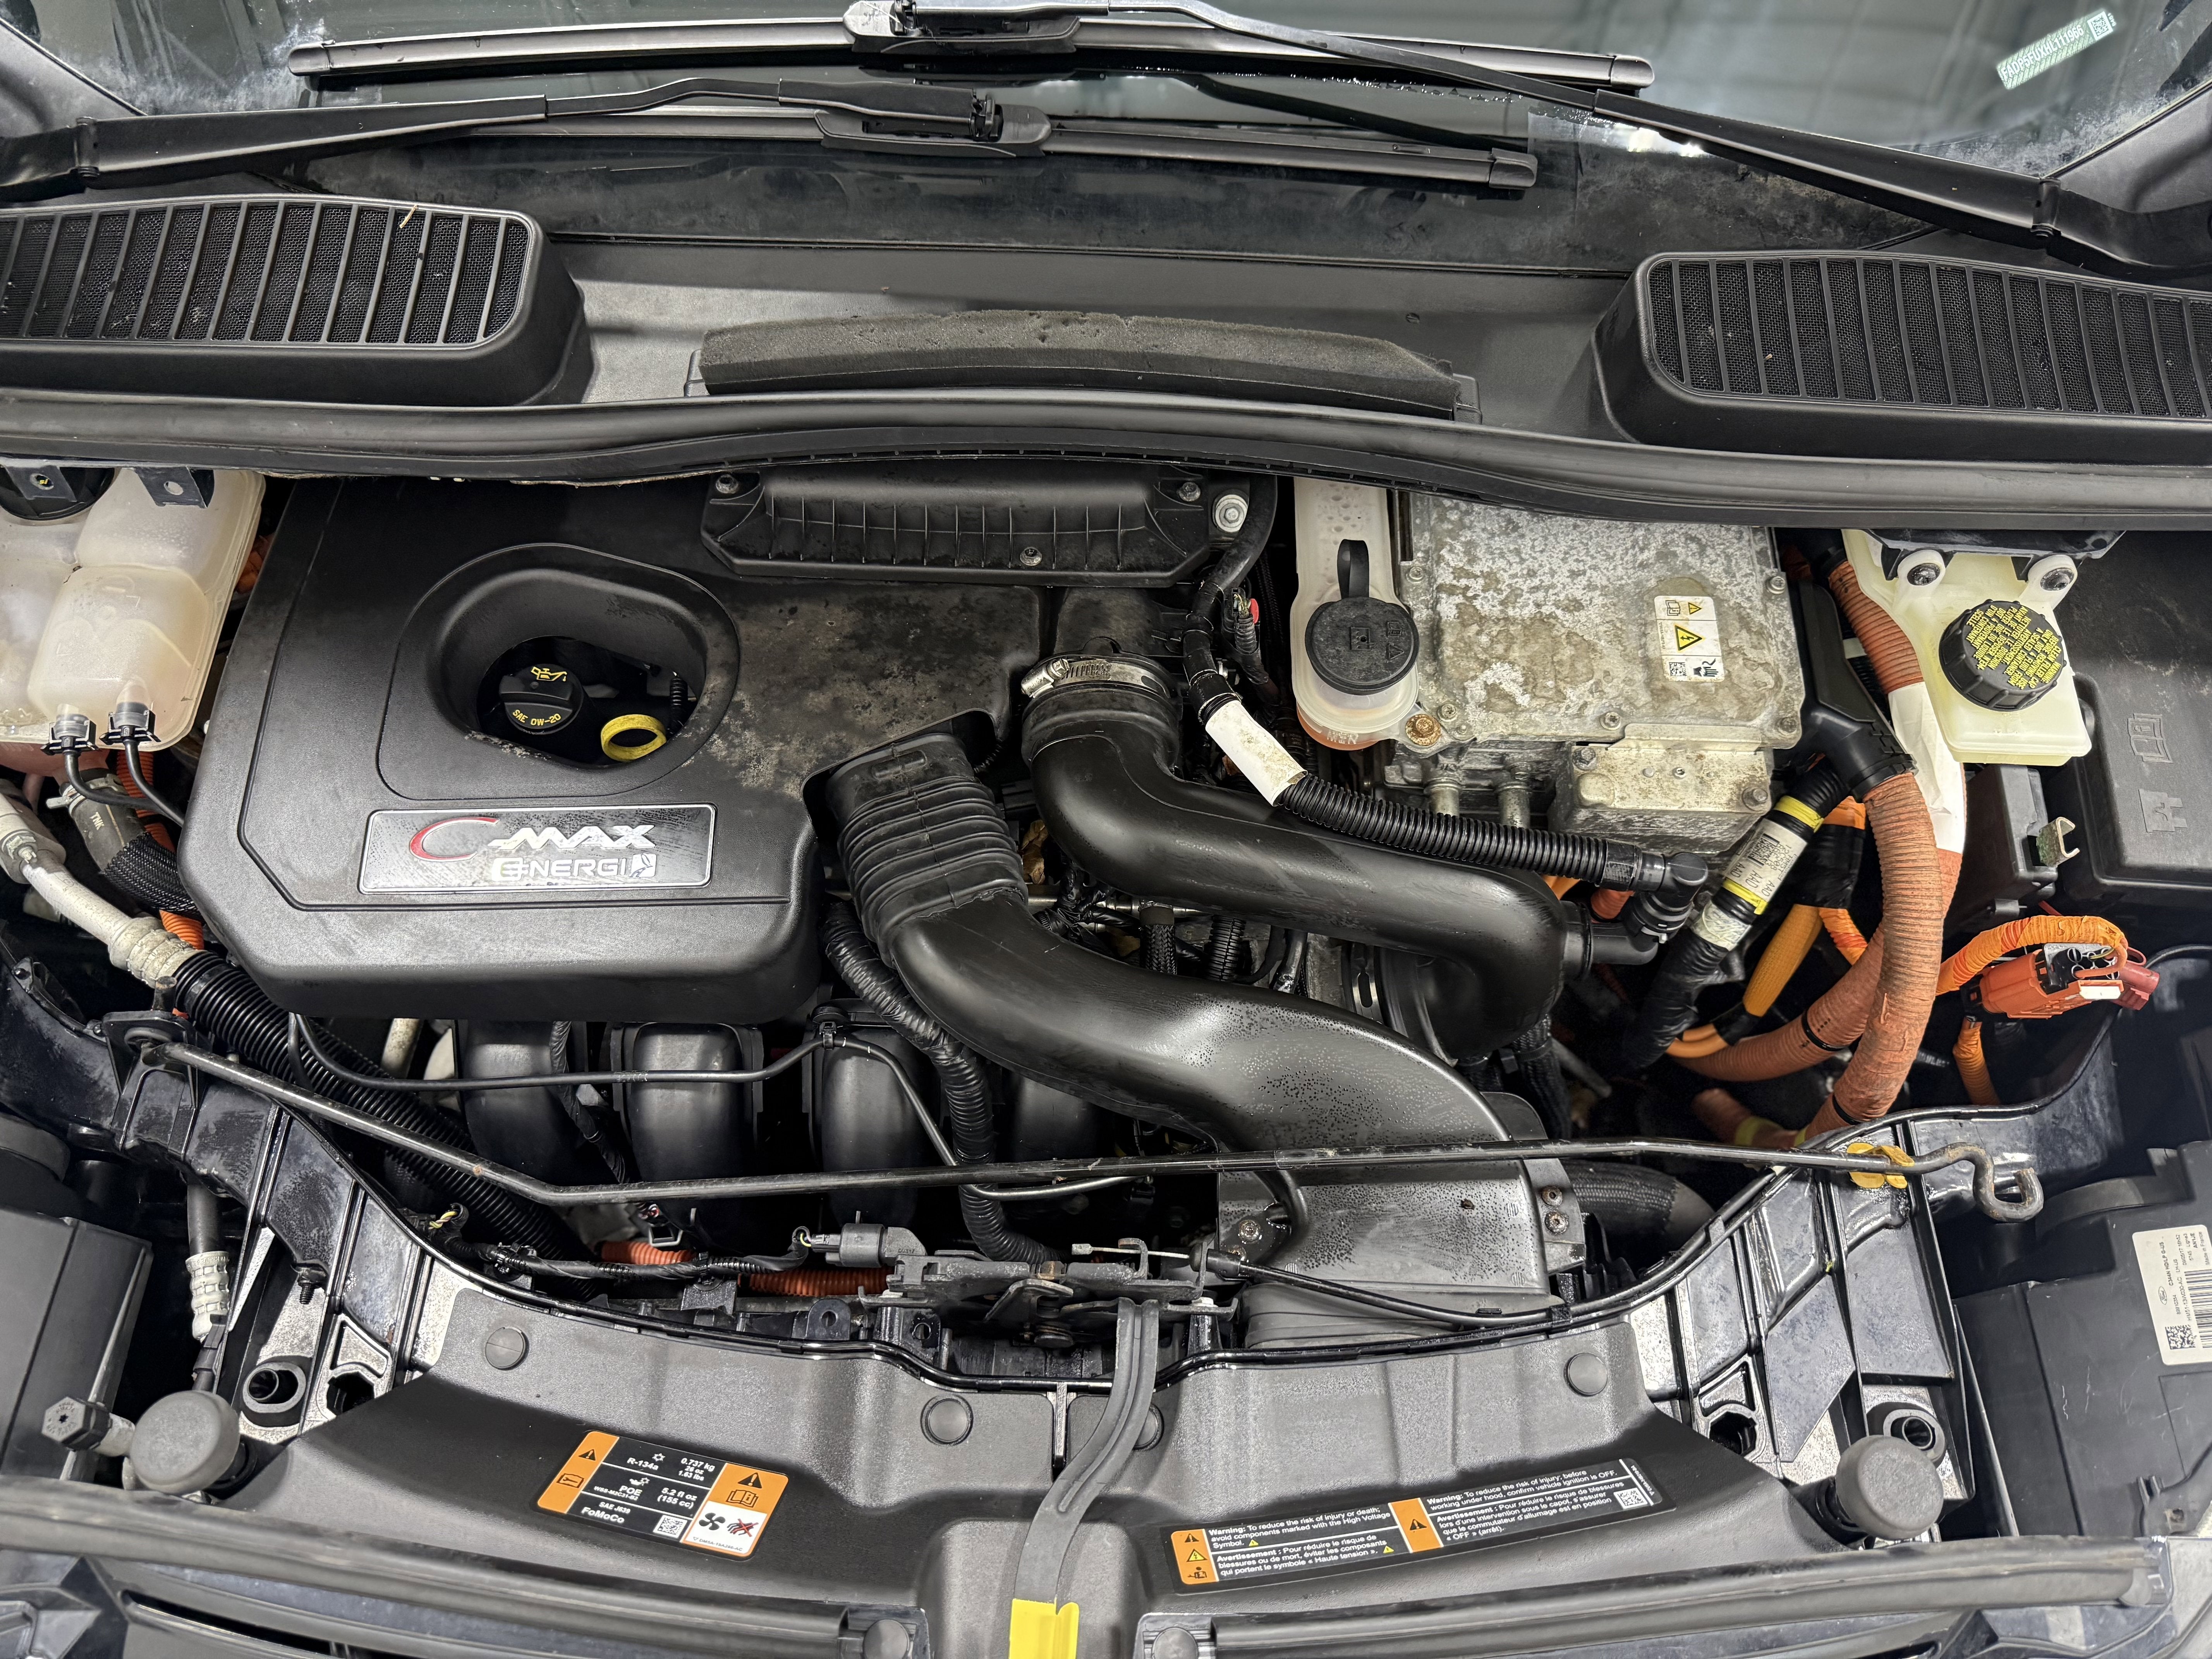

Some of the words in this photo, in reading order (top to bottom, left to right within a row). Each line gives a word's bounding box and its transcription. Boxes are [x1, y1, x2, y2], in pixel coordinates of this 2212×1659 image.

[1995, 608, 2006, 619] DOT
[2001, 606, 2018, 624] PLOYER
[2013, 606, 2028, 622] AVANT
[1966, 615, 1989, 644] CONTENANT
[1993, 622, 2004, 635] QUE
[2002, 627, 2012, 636] LE
[2008, 620, 2017, 629] DE
[2010, 615, 2031, 641] NETTOYER
[1972, 620, 1995, 650] PROVENANT
[1987, 632, 1997, 642] DU
[2004, 638, 2014, 647] LE
[2023, 632, 2040, 651] SEALED
[2040, 629, 2053, 643] ONLY
[1973, 640, 1991, 662] LIQUIDE
[2033, 641, 2044, 653] DOT
[2042, 635, 2059, 654] BEFORE
[1987, 645, 2008, 670] BOUCHON
[2047, 645, 2061, 662] CLEAN
[2019, 654, 2033, 671] FLUID
[2023, 651, 2046, 679] REMOVING.
[2035, 659, 2051, 678] FILLER
[2008, 669, 2023, 686] FROM
[2040, 662, 2061, 684] WARNING:
[2015, 676, 2028, 690] USE
[2026, 675, 2039, 689] CAP
[512, 709, 528, 723] SAE
[531, 713, 561, 726] 0W-20
[89, 812, 104, 830] TNK
[491, 857, 628, 881] ENERGI
[1729, 861, 1746, 879] AAD
[1744, 869, 1764, 890] AAD
[1760, 879, 1776, 897] AAD
[627, 1457, 658, 1470] R-134a
[680, 1458, 704, 1467] 0.737
[704, 1463, 715, 1472] kg
[619, 1485, 642, 1496] POE
[661, 1487, 676, 1496] 5.2
[1427, 1494, 1463, 1504] Warning:
[1475, 1487, 1501, 1495] reduce
[1562, 1470, 1587, 1479] before
[1430, 1501, 1460, 1510] working
[1507, 1487, 1534, 1496] confirm
[1535, 1482, 1561, 1490] vehicle
[1562, 1477, 1589, 1486] ignition
[599, 1501, 615, 1510] SAE
[657, 1494, 678, 1504] (155
[678, 1501, 694, 1509] cc)
[1437, 1507, 1493, 1522] Avertissement
[1518, 1498, 1544, 1507] réduire
[1588, 1482, 1624, 1492] blessures
[581, 1506, 624, 1523] FoMoCo
[1467, 1516, 1515, 1530] commutateur
[1582, 1498, 1611, 1508] position
[1477, 1509, 1520, 1521] intervention
[1208, 1527, 1246, 1535] Warning:
[1233, 1529, 1280, 1540] components
[1281, 1524, 1310, 1533] marked
[1361, 1512, 1390, 1520] Voltage
[1453, 1531, 1469, 1539] OFF
[1216, 1549, 1276, 1563] Avertissement
[1218, 1560, 1256, 1568] blessures
[1340, 1540, 1387, 1552] composants
[1234, 1565, 1263, 1575] portent
[1273, 1559, 1306, 1570] symbole
[1340, 1550, 1369, 1559] tension
